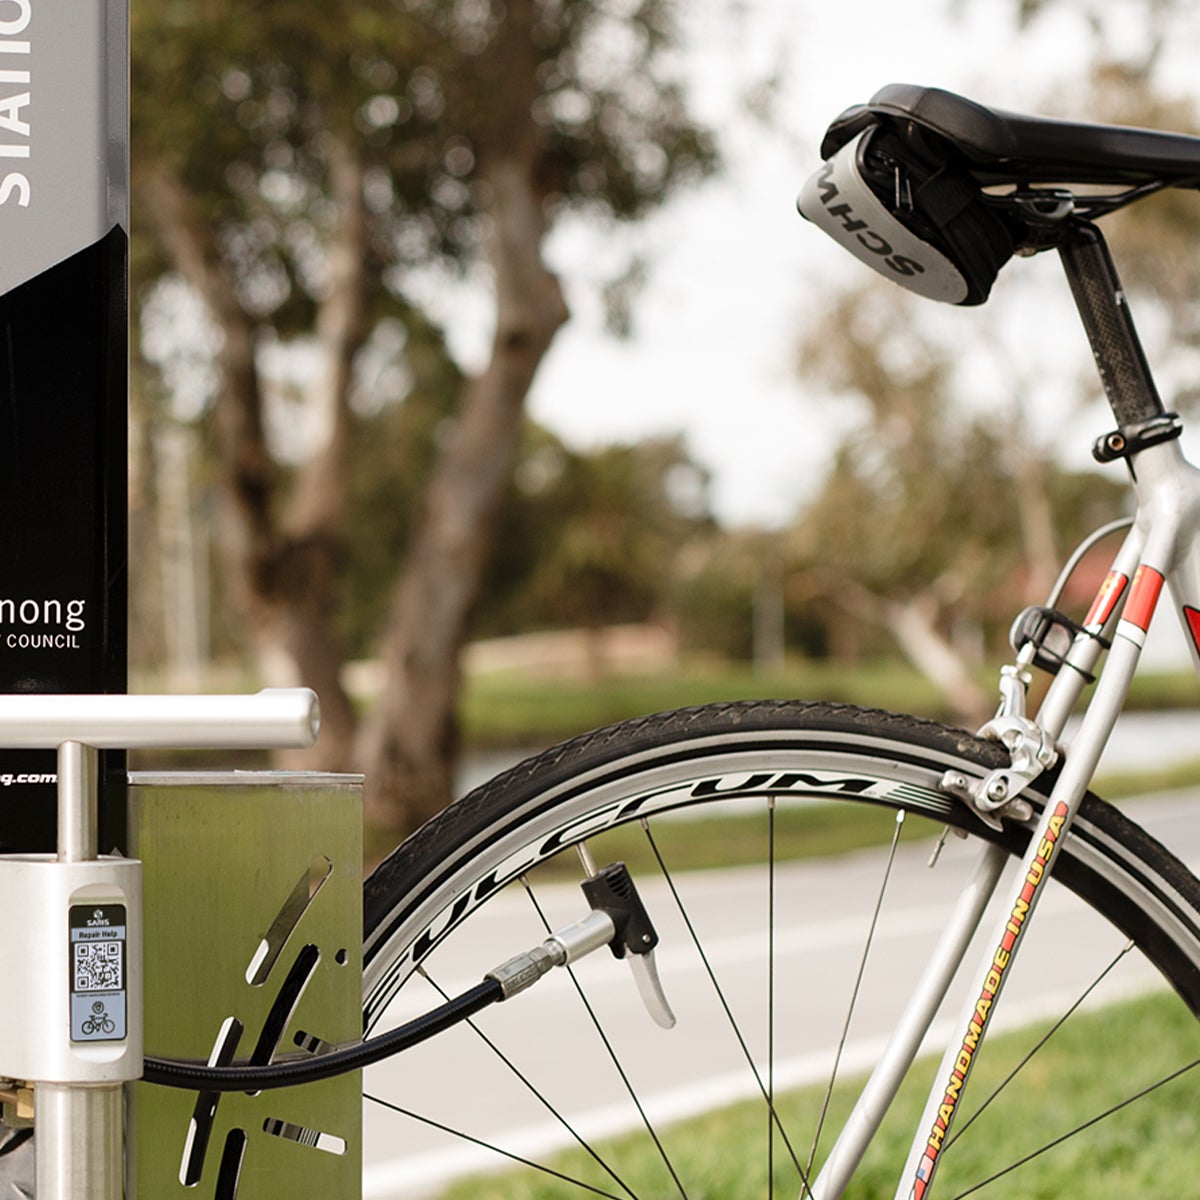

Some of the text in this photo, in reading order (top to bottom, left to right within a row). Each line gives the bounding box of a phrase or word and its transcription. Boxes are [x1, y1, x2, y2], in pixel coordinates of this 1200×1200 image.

[6, 633, 80, 649] COUNCIL
[101, 929, 118, 939] Help
[928, 813, 1067, 1150] HANDMADE IN USA
